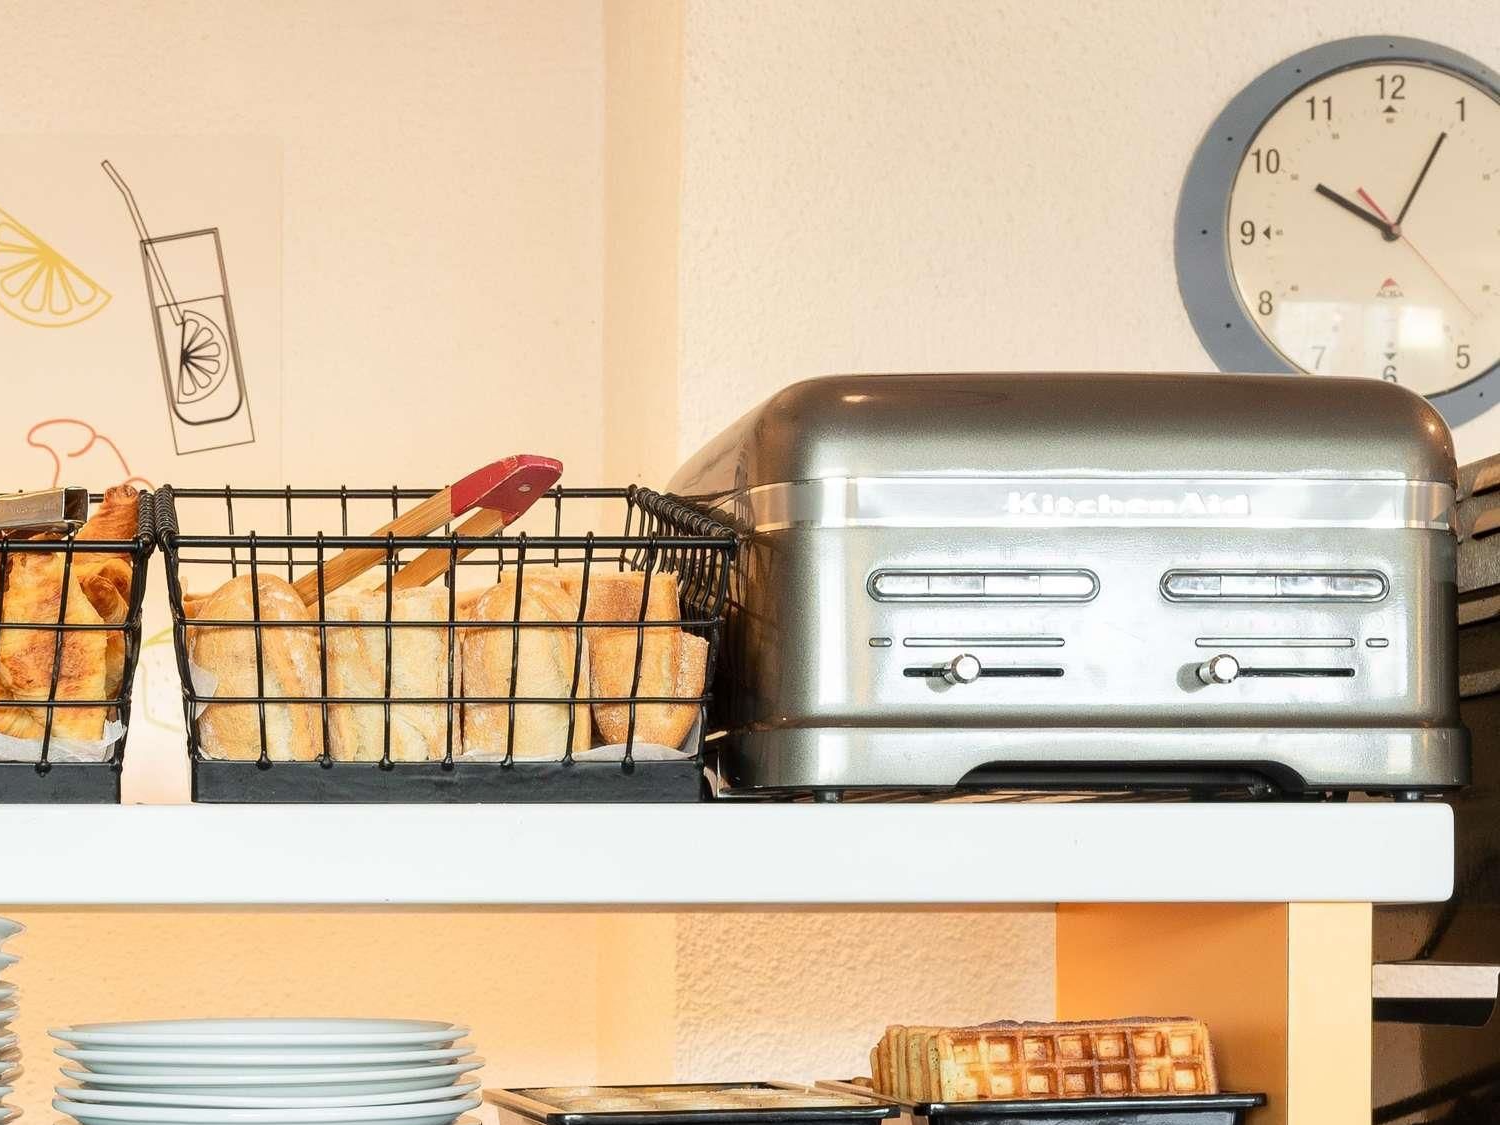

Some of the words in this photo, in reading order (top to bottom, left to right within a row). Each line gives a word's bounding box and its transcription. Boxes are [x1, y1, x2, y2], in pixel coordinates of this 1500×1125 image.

[1375, 74, 1406, 100] 12
[1306, 96, 1332, 121] 11
[1455, 97, 1466, 122] 1
[1251, 148, 1280, 174] 10
[1240, 220, 1255, 246] 9
[1258, 290, 1273, 316] 8
[1311, 346, 1327, 370] 7
[1456, 344, 1470, 369] 5
[1382, 365, 1398, 384] 6
[1003, 490, 1251, 515] KitchenAid
